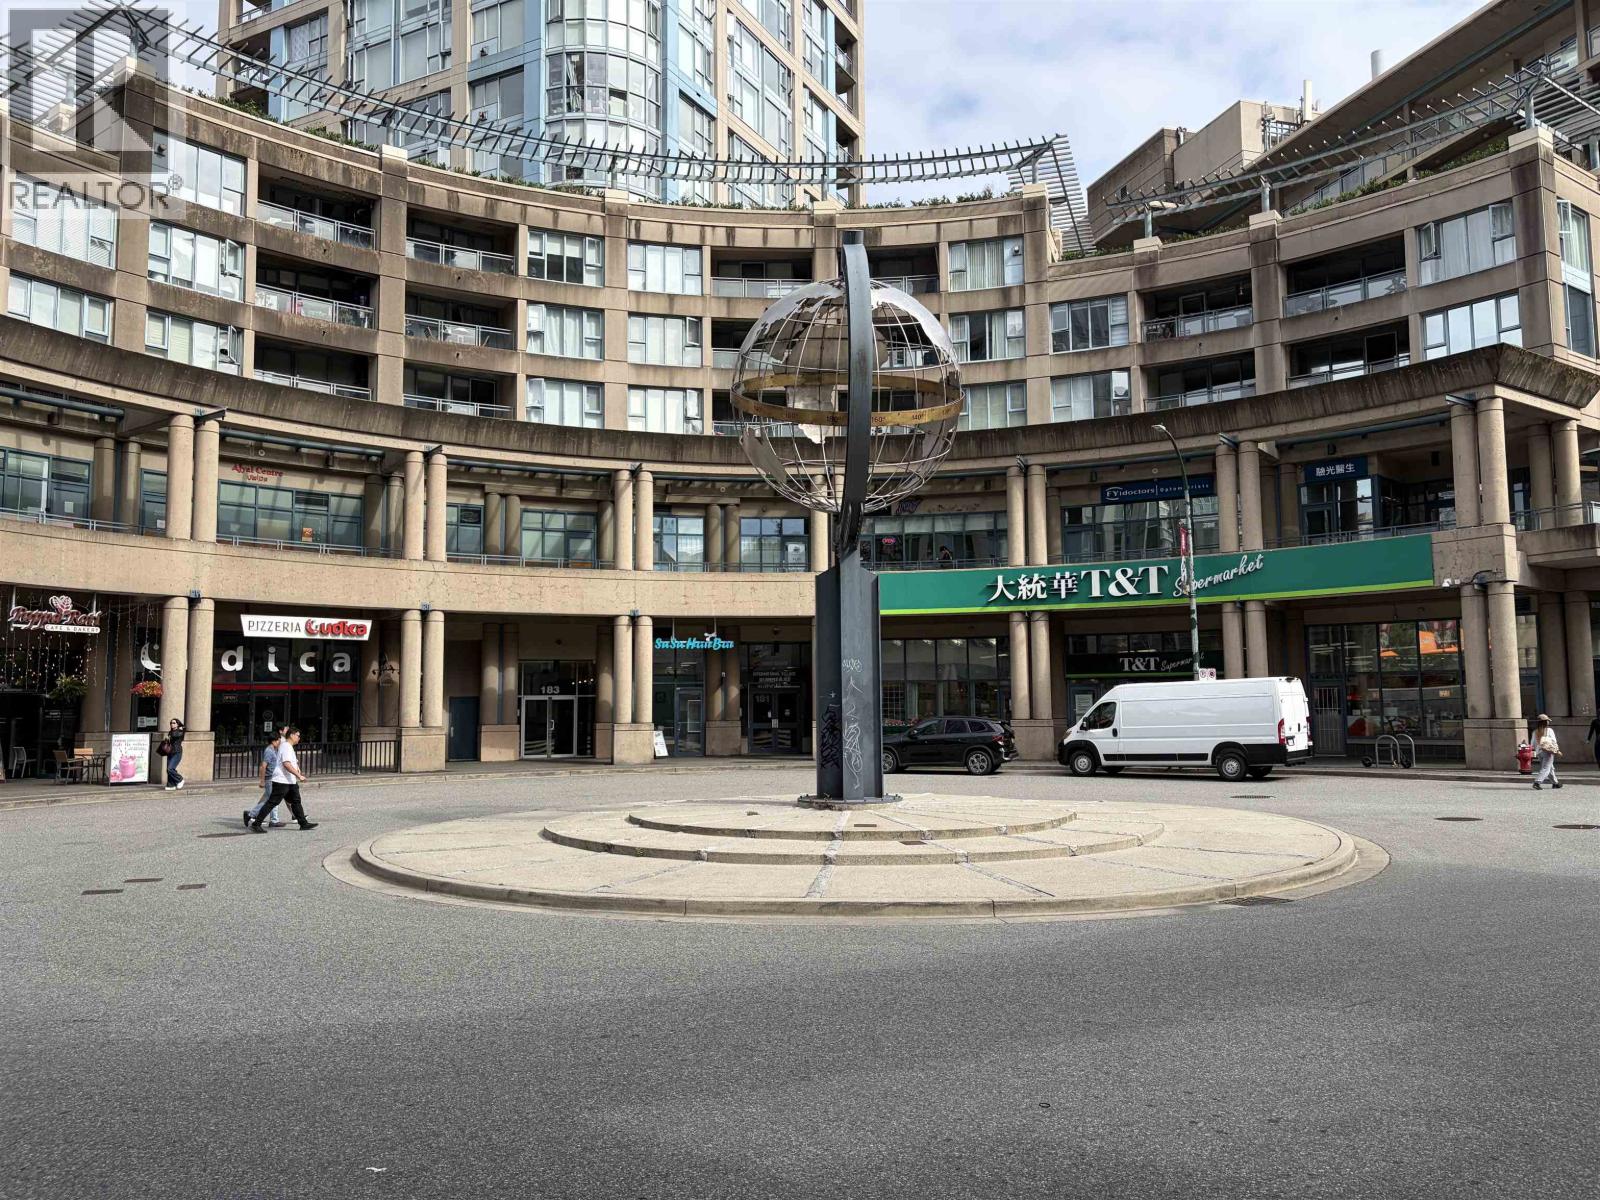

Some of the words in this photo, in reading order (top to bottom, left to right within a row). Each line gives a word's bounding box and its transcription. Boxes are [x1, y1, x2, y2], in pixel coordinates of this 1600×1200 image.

[1160, 483, 1209, 492] Optomrists
[1080, 565, 1169, 598] T&T
[1172, 553, 1264, 597] Spermarket
[987, 574, 1079, 602] 大統華
[247, 620, 301, 633] PIZZERIA
[1120, 657, 1159, 671] T&T
[540, 686, 560, 694] 183
